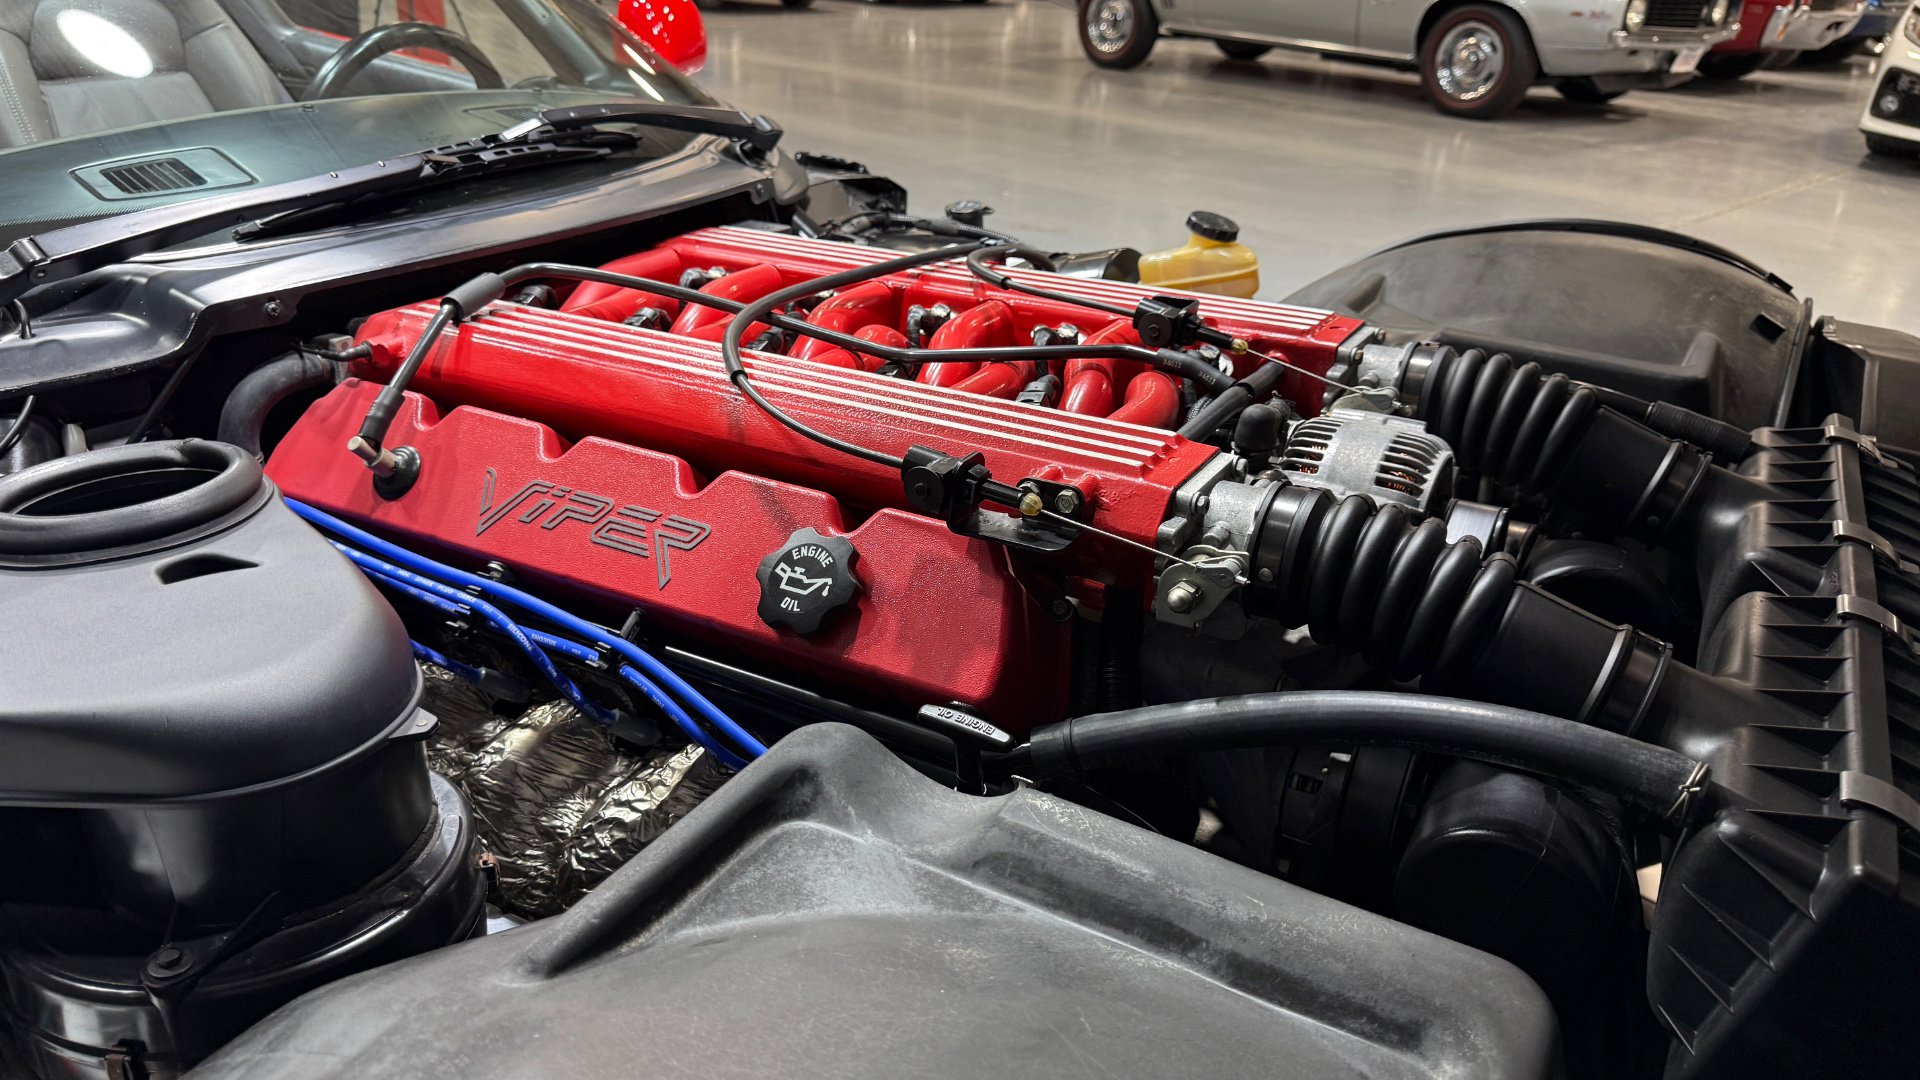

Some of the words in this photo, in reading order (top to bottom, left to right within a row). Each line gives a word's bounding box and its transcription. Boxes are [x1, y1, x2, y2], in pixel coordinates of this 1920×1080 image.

[791, 545, 834, 568] ENGINE
[780, 596, 801, 612] OIL
[506, 623, 534, 651] SILICONE
[937, 707, 954, 719] OIL
[954, 714, 996, 736] ENGINE
